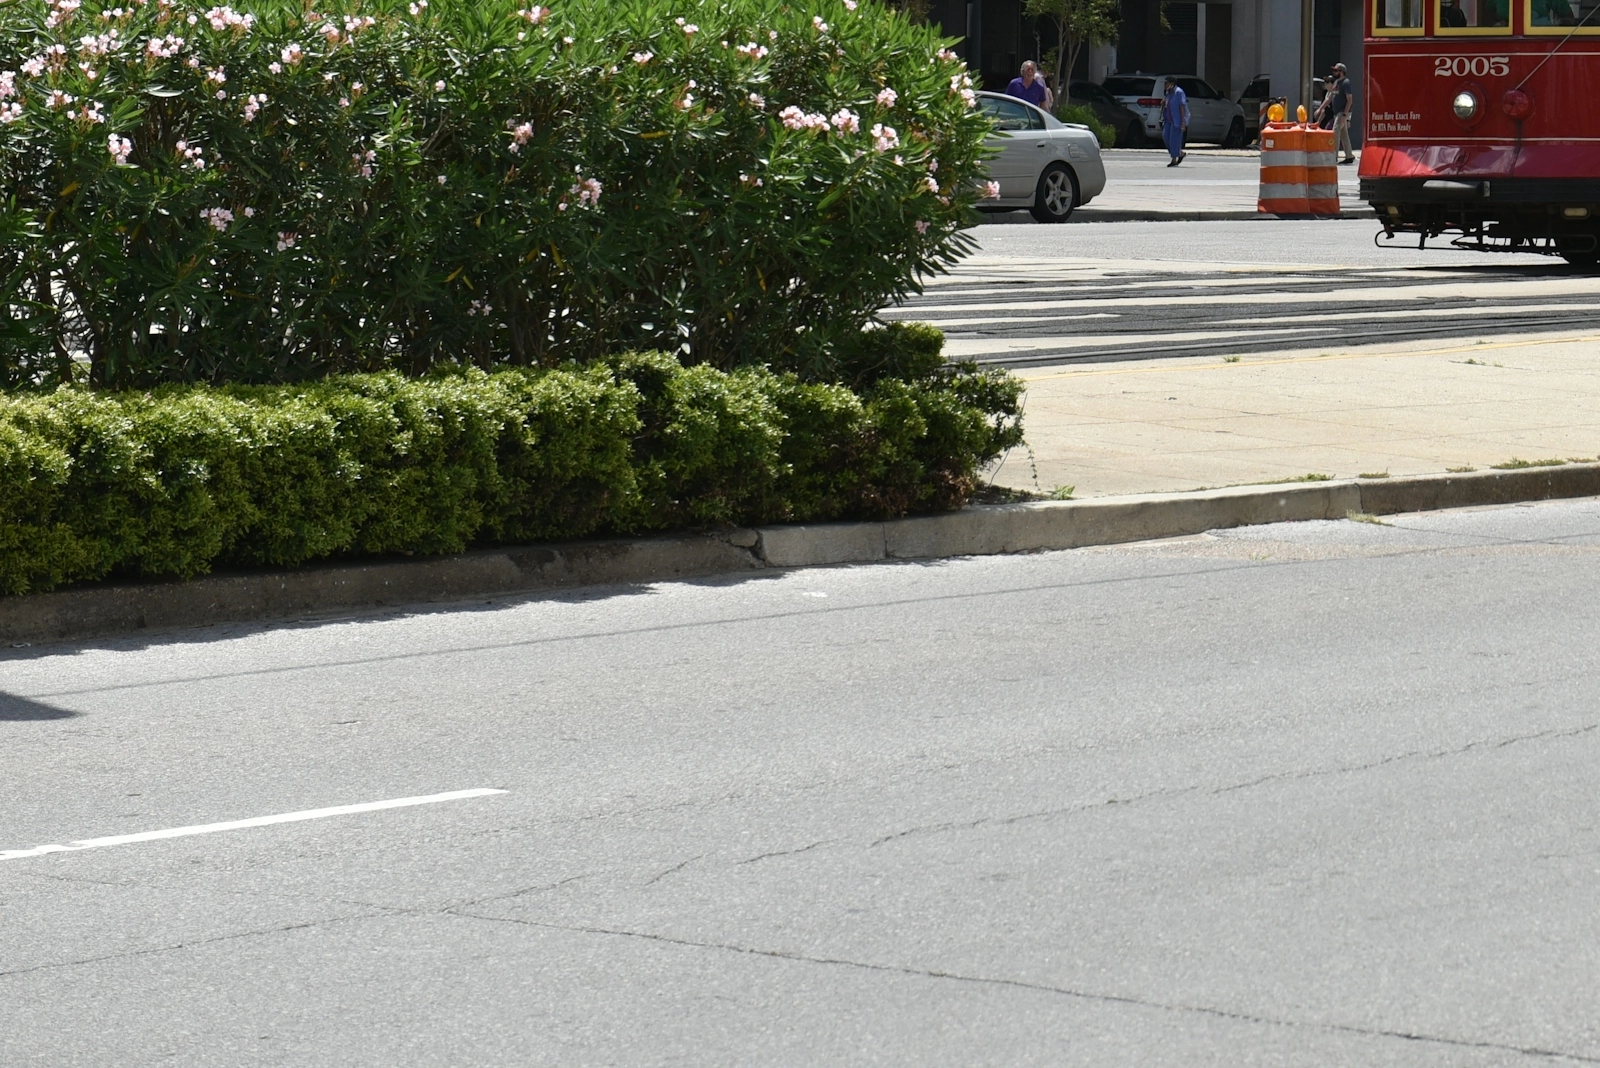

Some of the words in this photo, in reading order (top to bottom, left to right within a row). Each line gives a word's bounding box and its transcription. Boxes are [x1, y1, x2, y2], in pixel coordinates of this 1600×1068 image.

[1434, 56, 1510, 77] 2005
[1372, 112, 1384, 120] Please
[1384, 112, 1394, 120] Have
[1395, 111, 1408, 120] Exact
[1410, 111, 1421, 120] Fare
[1372, 123, 1378, 132] Or
[1378, 123, 1386, 132] RTA
[1387, 123, 1396, 132] Pass
[1397, 123, 1412, 132] Ready
